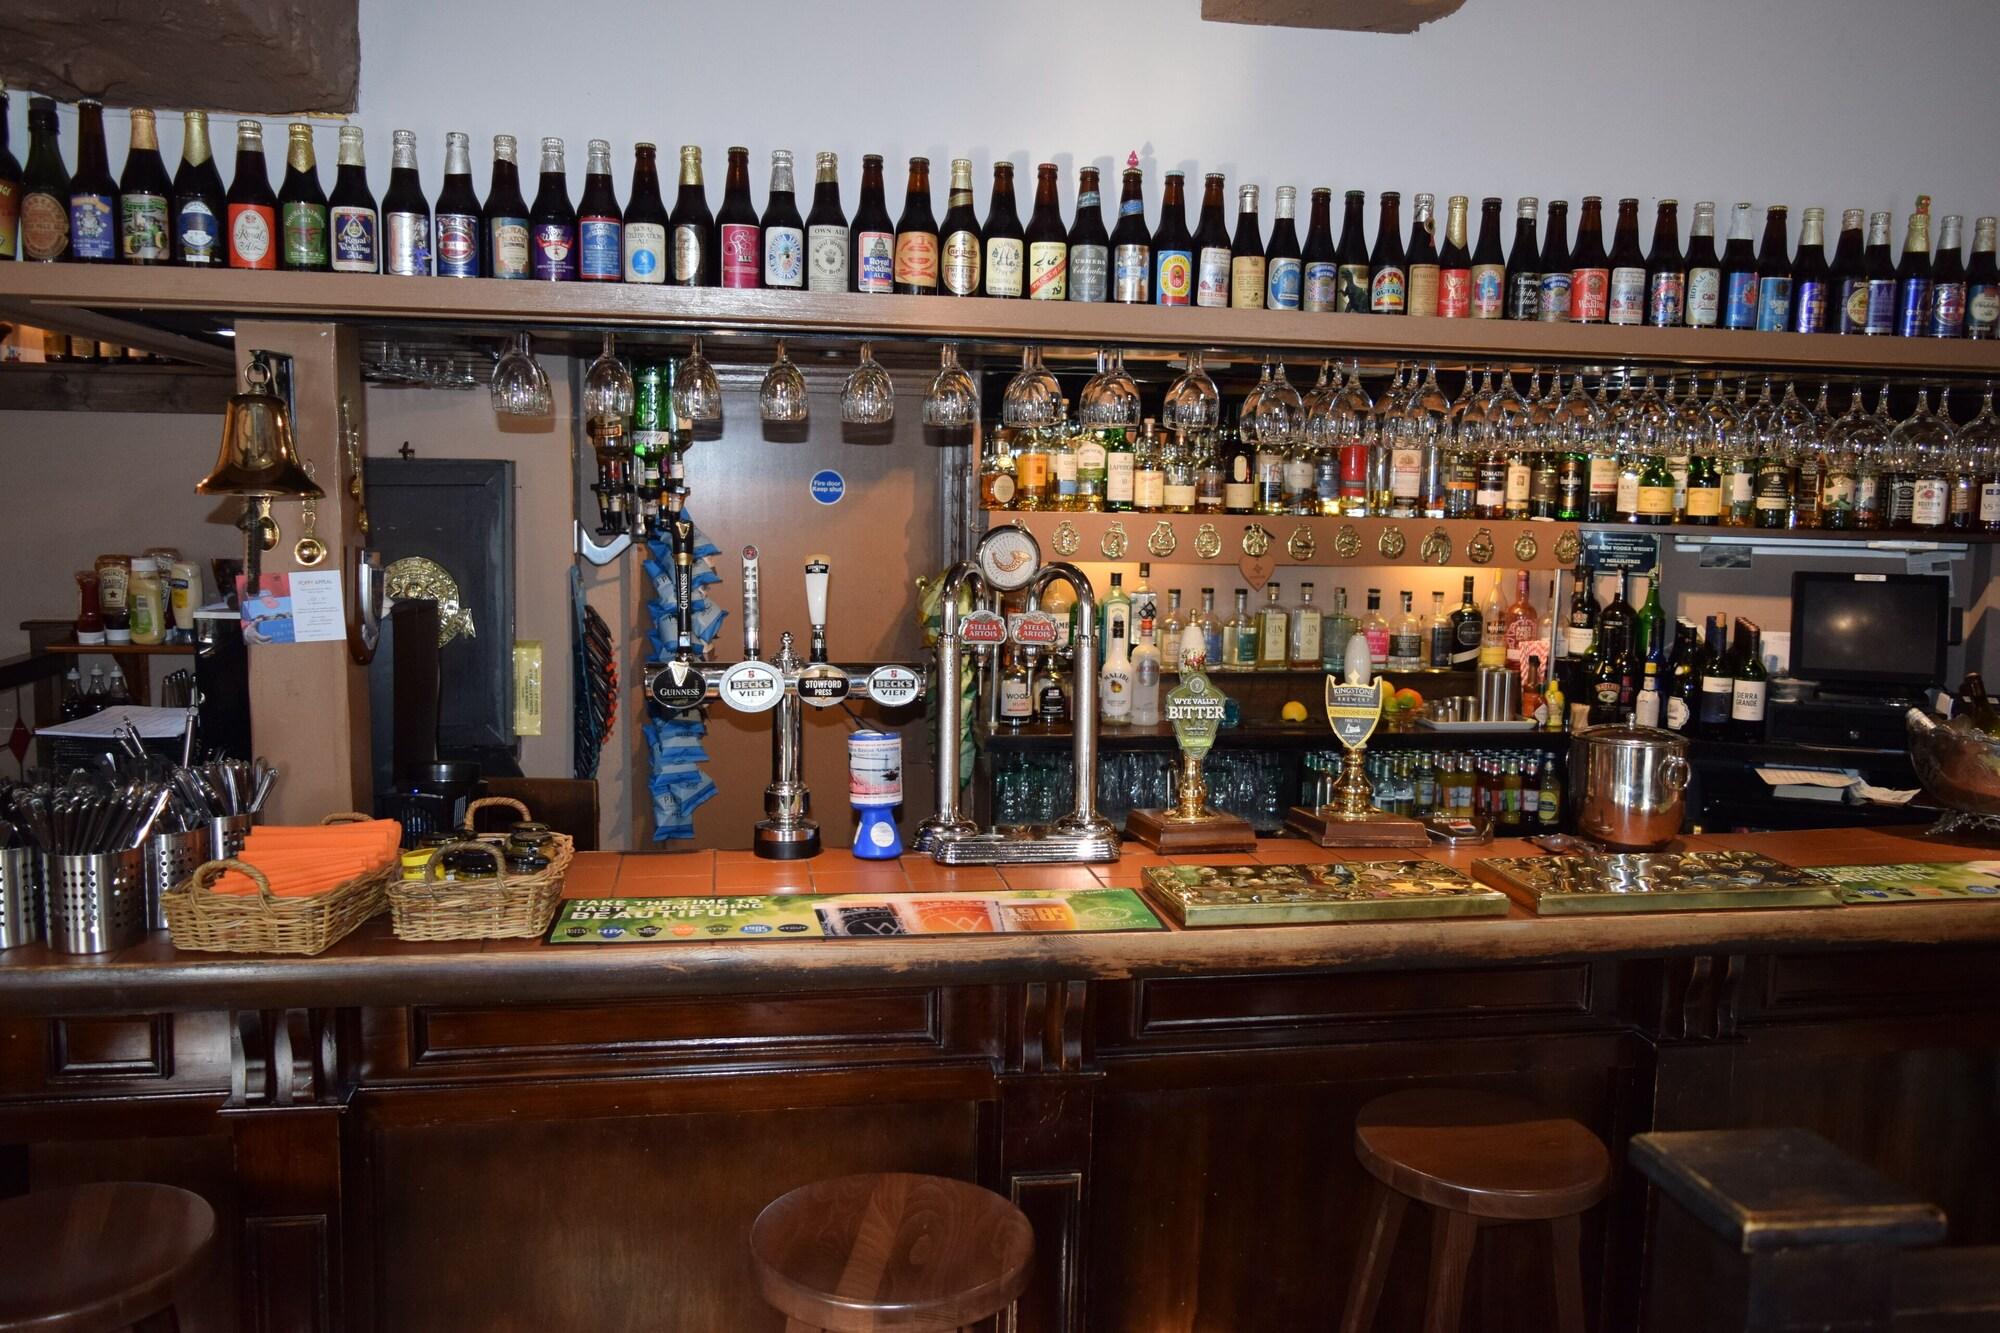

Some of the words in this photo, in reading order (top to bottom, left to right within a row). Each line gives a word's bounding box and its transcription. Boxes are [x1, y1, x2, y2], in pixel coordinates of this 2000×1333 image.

[345, 236, 367, 245] Royal
[339, 243, 371, 252] Wedding
[347, 251, 363, 260] Ale
[869, 258, 890, 267] Royal
[680, 572, 688, 610] GUINNESS
[731, 679, 773, 690] BECK'S
[805, 680, 842, 689] STOWFORD
[873, 678, 913, 689] BECK'S
[660, 687, 700, 697] GUINNESS
[1334, 687, 1375, 697] KINGSTONE
[1736, 692, 1758, 700] SIERRA
[1174, 697, 1192, 705] WYE
[1192, 697, 1219, 705] VALLEY
[1735, 699, 1758, 707] GRANDE
[1168, 705, 1225, 719] BITTER
[570, 909, 746, 920] BEAUTIFUL
[597, 927, 626, 935] HPA
